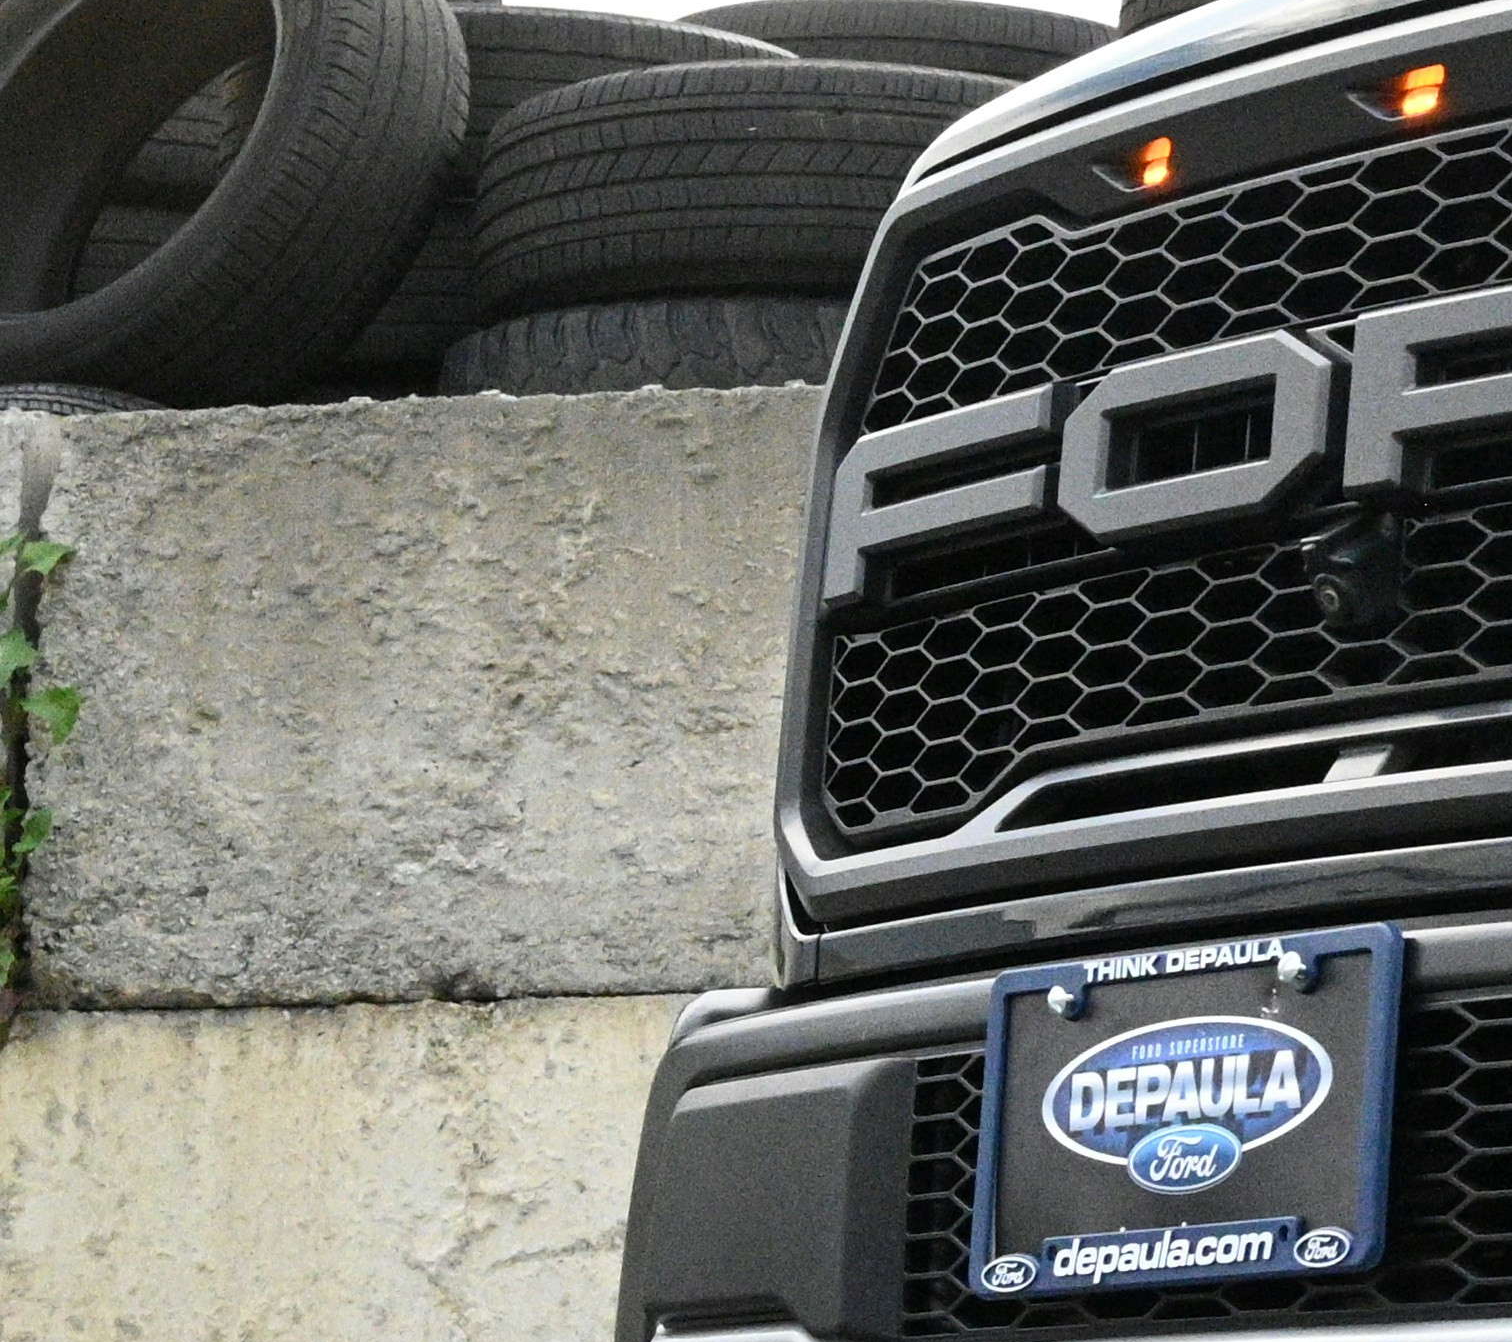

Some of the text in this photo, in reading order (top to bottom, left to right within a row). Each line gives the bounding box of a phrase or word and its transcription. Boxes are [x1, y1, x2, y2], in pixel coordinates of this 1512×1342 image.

[1084, 938, 1284, 983] THINK DEPAULA
[1131, 1033, 1245, 1061] FORD SUPERSTORE
[1069, 1049, 1302, 1133] DEPAULA
[1149, 1135, 1218, 1182] Ford
[1053, 1230, 1273, 1284] depaula.com
[1303, 1239, 1340, 1261] Ford
[990, 1263, 1026, 1285] Ford
